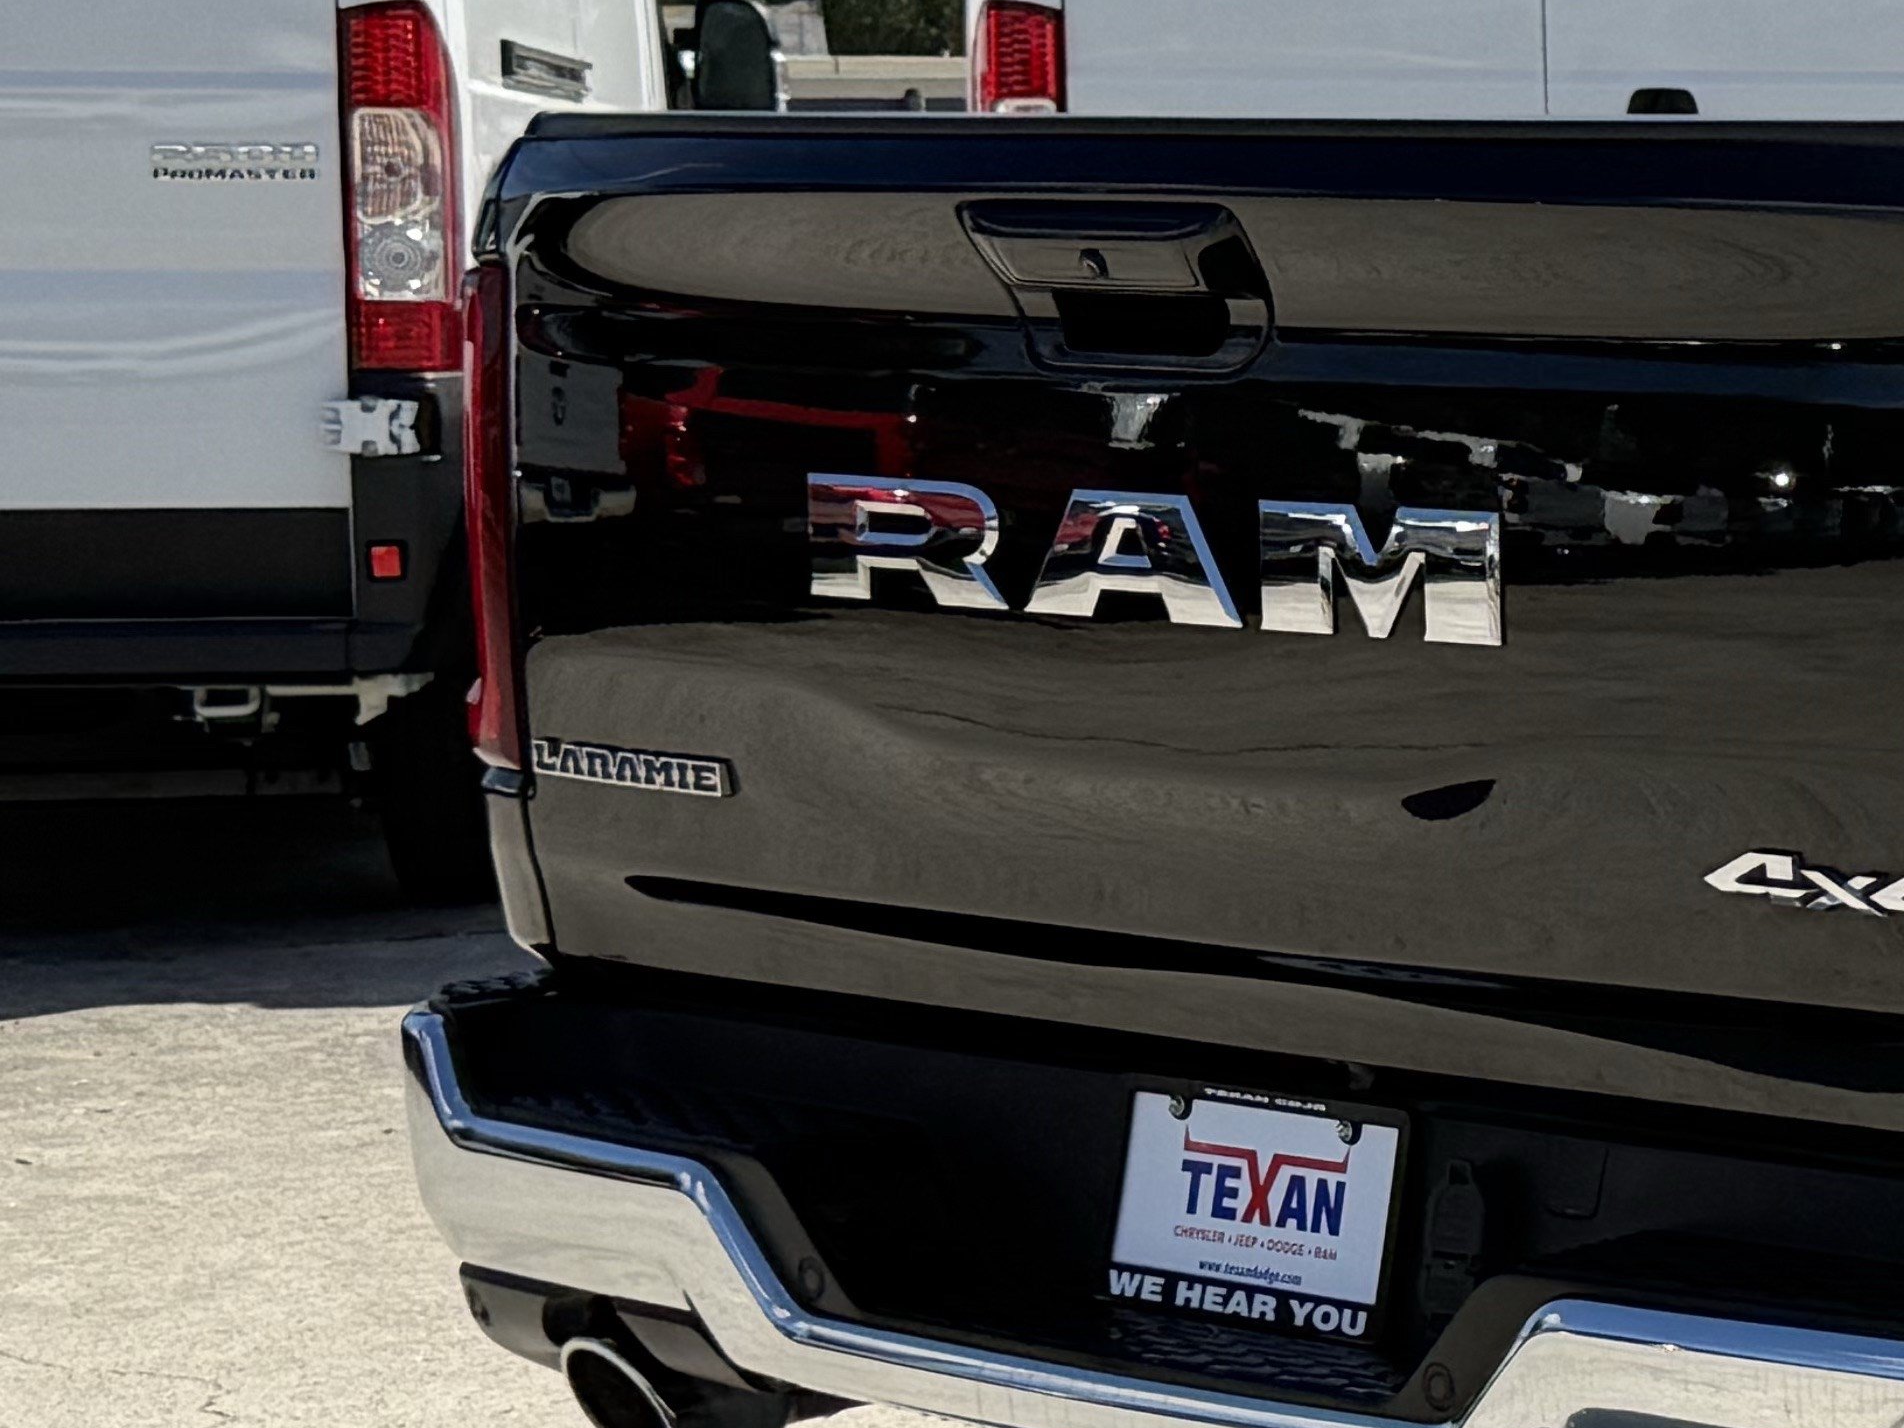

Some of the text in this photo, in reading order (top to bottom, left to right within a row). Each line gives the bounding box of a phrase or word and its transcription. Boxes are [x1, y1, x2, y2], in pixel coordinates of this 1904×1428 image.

[807, 472, 1502, 647] RAM
[533, 739, 722, 797] LARAMIE
[1182, 1136, 1347, 1237] TEXAN
[1174, 1224, 1226, 1244] CHRYSLER
[1233, 1233, 1259, 1249] JEEP
[1266, 1238, 1306, 1257] DODGE
[1108, 1269, 1368, 1337] WE HEAR YOU
